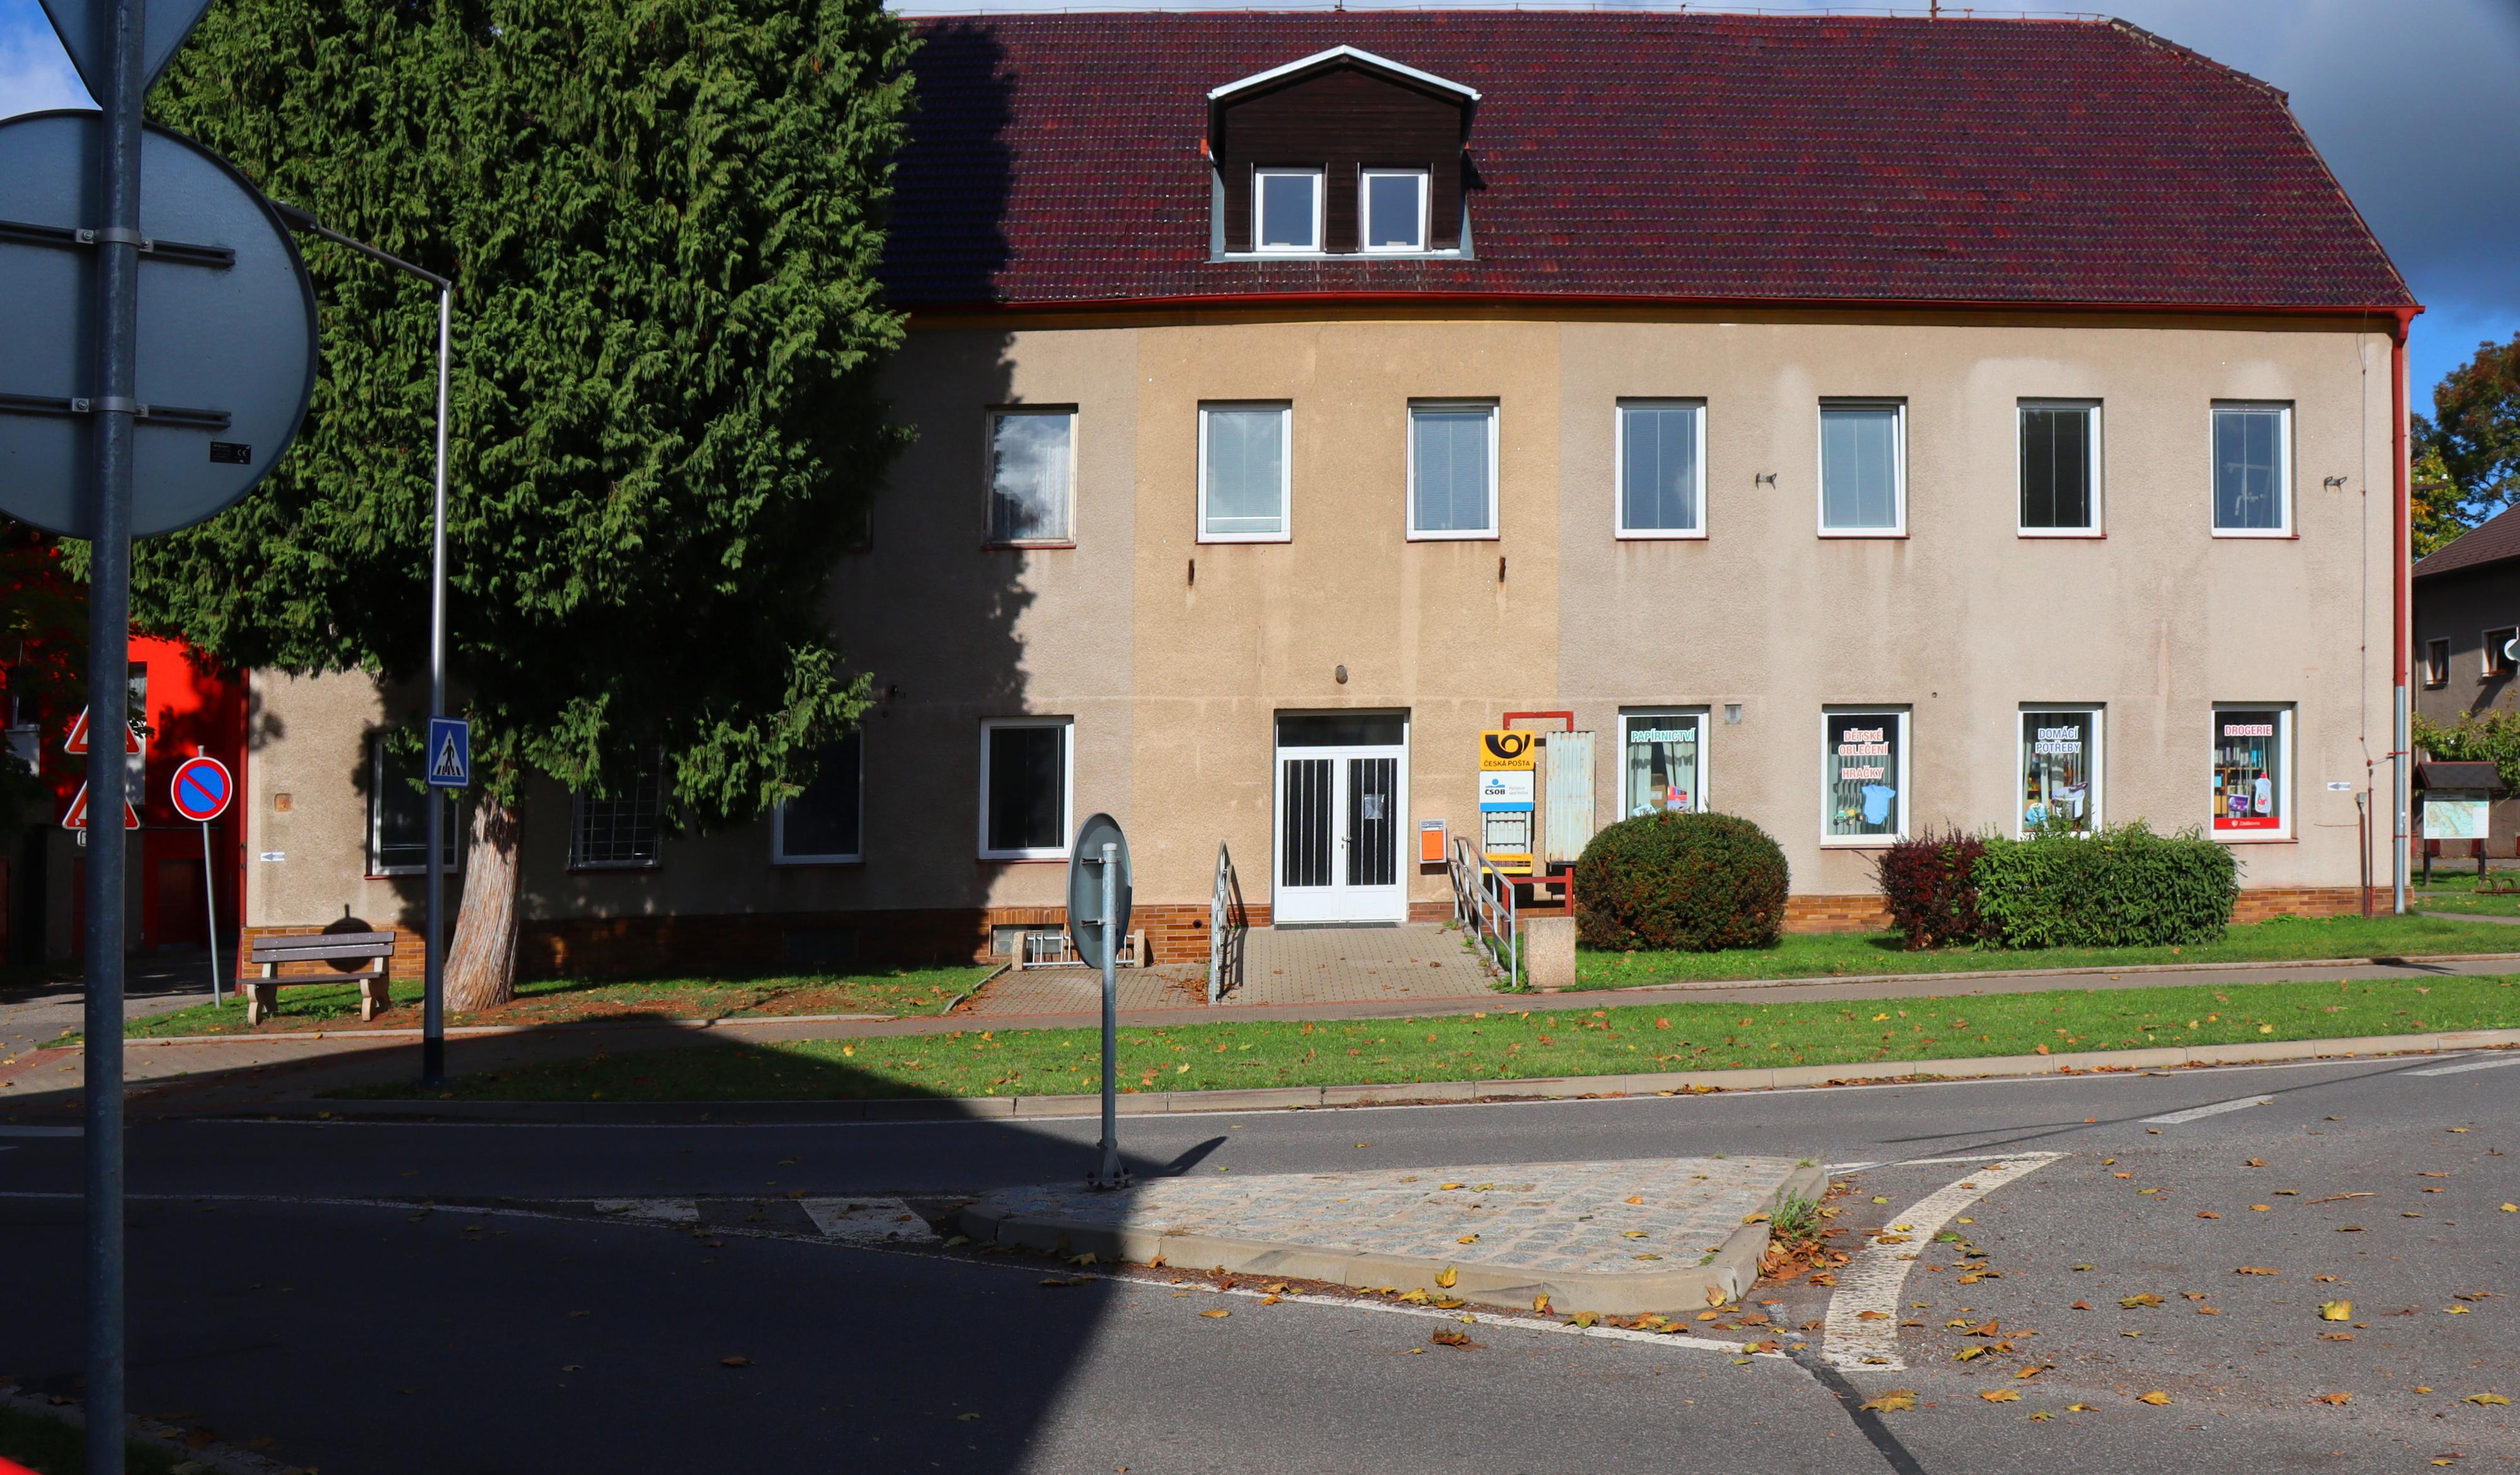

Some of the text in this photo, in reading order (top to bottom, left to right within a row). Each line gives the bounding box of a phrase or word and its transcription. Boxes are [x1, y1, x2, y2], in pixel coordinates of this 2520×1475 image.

[1631, 727, 1696, 743] PAPÍRNICTVÍ
[1843, 727, 1883, 742] DĚTSKÉ
[2038, 726, 2079, 739] DOMÁCÍ
[2225, 725, 2272, 736] DROGERIE
[1838, 741, 1889, 756] OBLEČENÍ
[2035, 740, 2082, 754] POTŘEBY
[1842, 765, 1884, 779] HRAČKY
